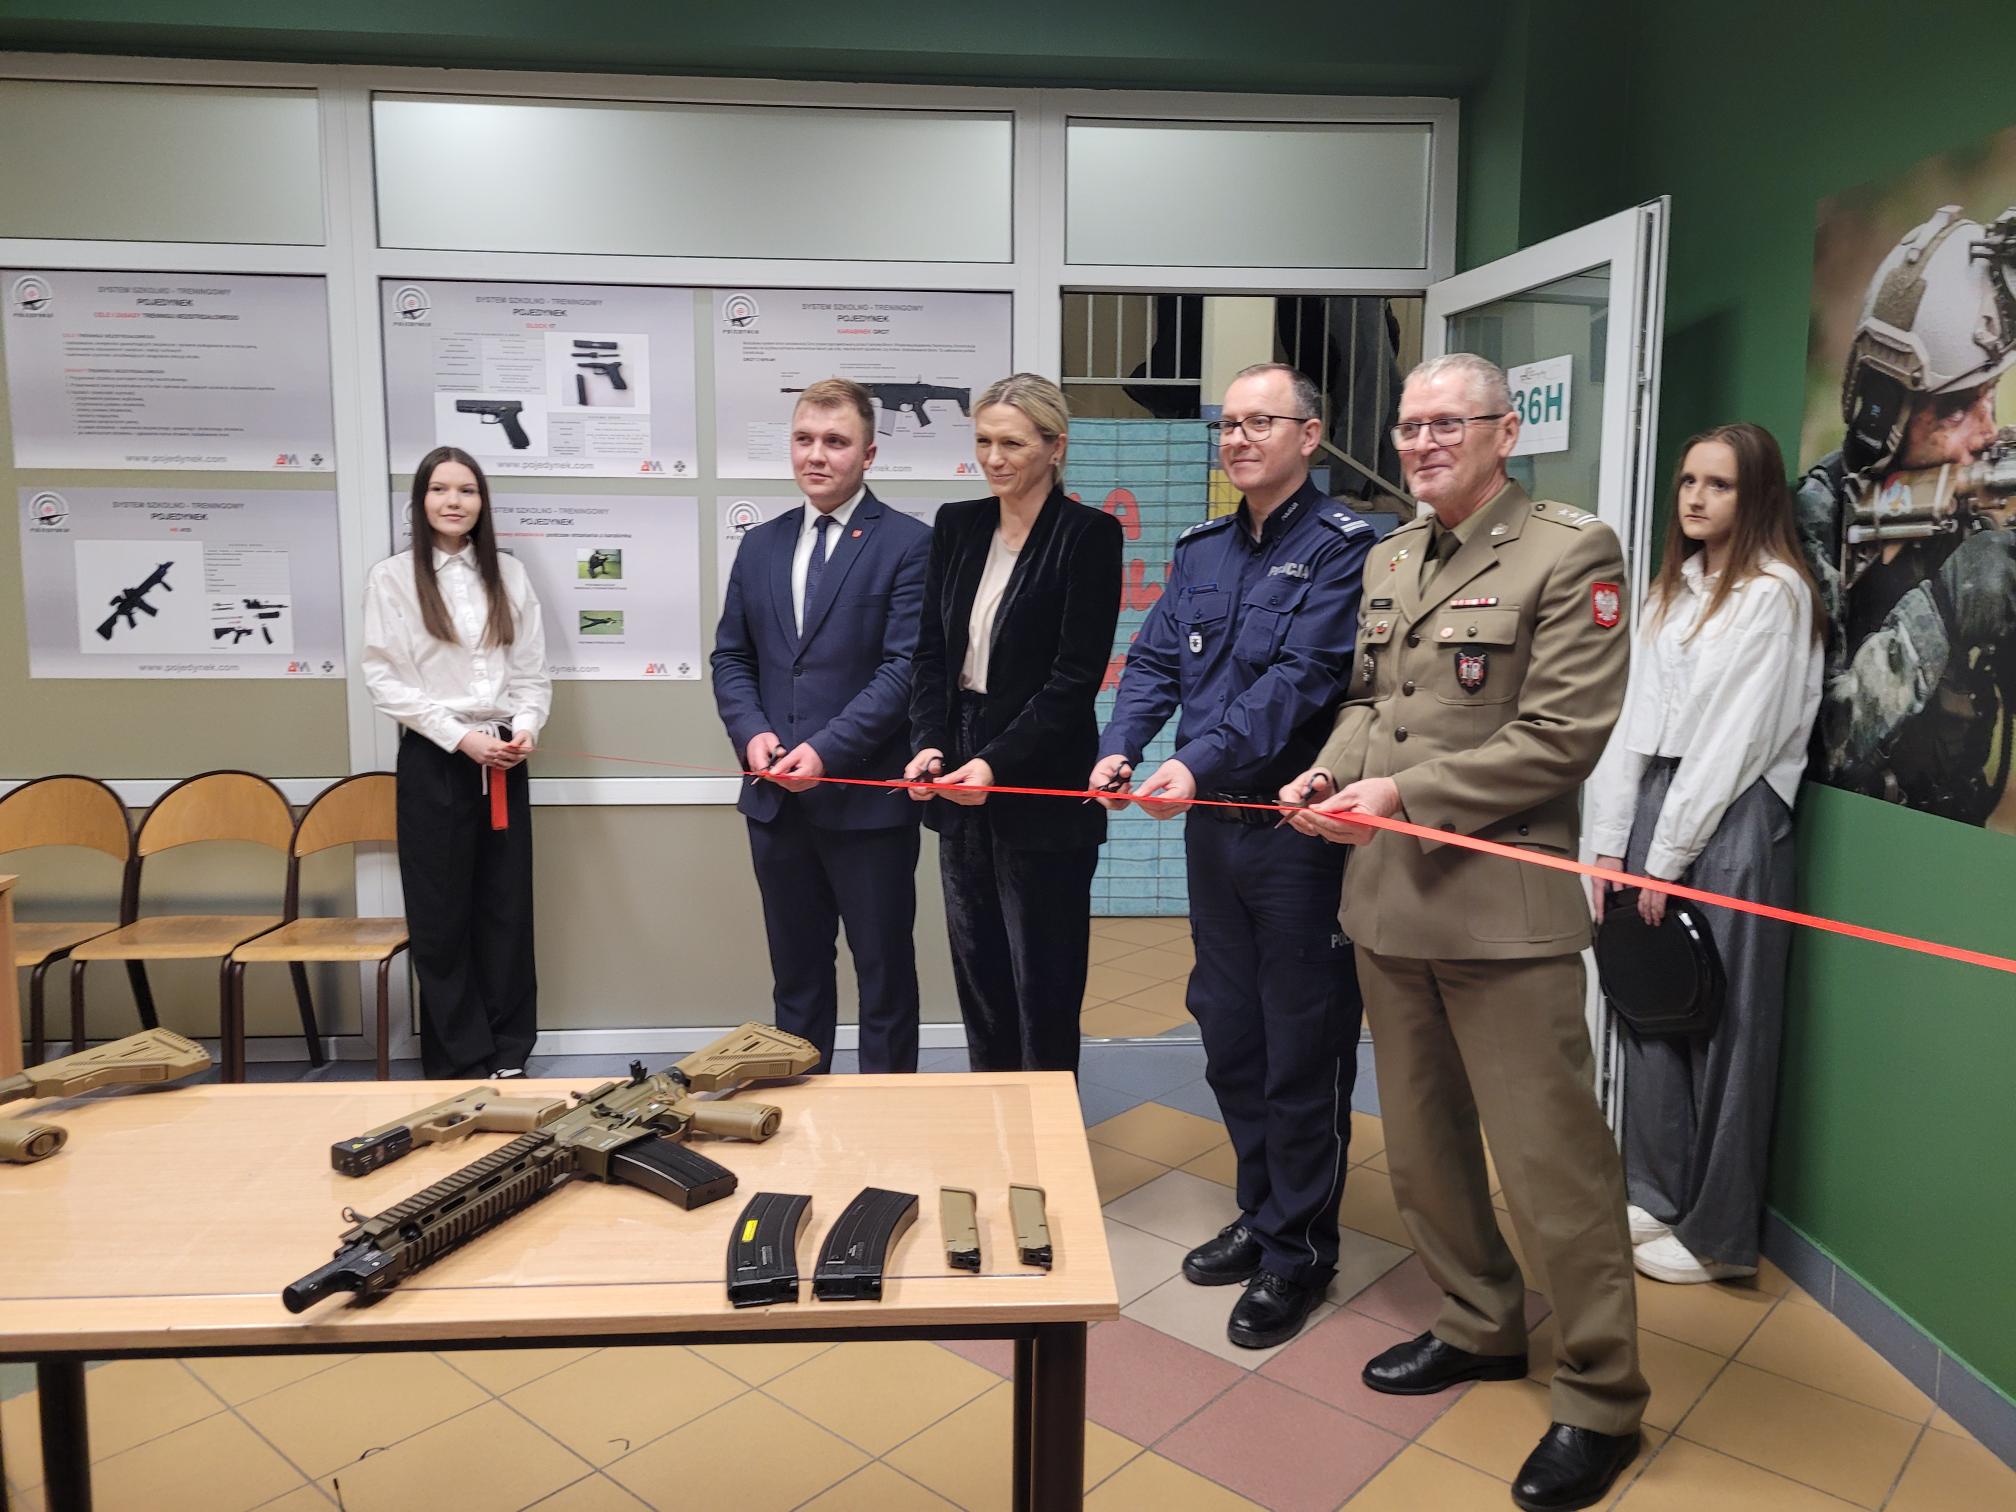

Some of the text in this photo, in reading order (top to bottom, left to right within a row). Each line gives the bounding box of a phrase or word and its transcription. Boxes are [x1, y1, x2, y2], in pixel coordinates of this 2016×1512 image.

[136, 298, 194, 307] POJEDYNEK
[475, 296, 506, 304] SYSTEM
[801, 303, 832, 311] SYSTEM
[874, 304, 924, 312] TRENINGOWY
[512, 308, 568, 317] POJEDYNEK
[837, 314, 890, 323] POJEDYNEK
[1508, 383, 1563, 426] 36H
[125, 455, 228, 464] www.pojedynek.com
[496, 461, 595, 471] www.pojedynek.com
[489, 506, 513, 514] STEM
[150, 512, 208, 521] POJEDYNEK
[519, 518, 575, 526] POJEDYNEK
[139, 664, 240, 673] www.pojedynek.com
